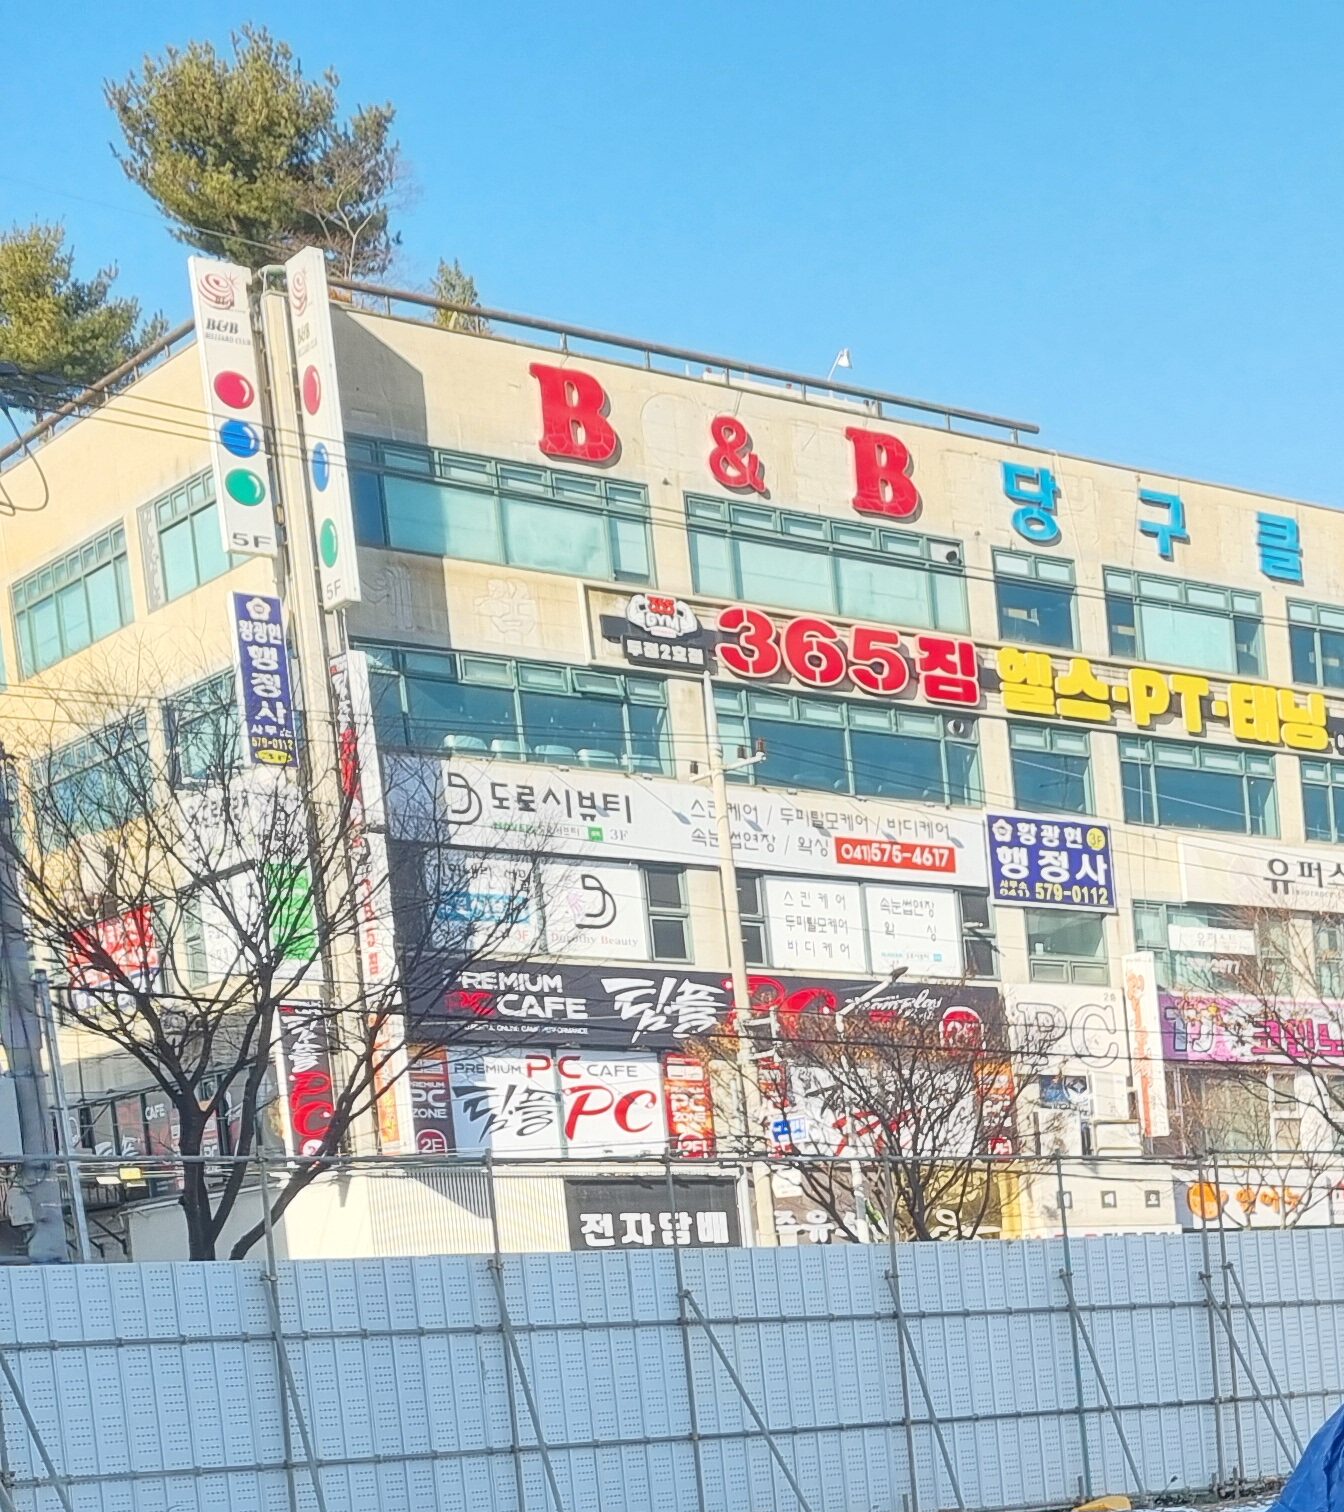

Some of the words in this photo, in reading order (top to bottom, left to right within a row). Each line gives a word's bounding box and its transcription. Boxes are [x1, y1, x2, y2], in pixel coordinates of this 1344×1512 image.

[205, 317, 239, 335] B&B
[529, 362, 617, 462] B
[709, 414, 766, 493] &
[844, 426, 921, 518] B
[231, 532, 272, 548] 5F
[326, 579, 342, 600] 5F
[645, 612, 681, 633] GYM
[716, 607, 981, 705] 365짐
[246, 644, 288, 725] 행정사
[251, 737, 294, 751] 579-0112
[490, 782, 632, 824] 도로시뷰티
[610, 828, 629, 841] 3F
[886, 818, 950, 840] 바디케어
[841, 842, 950, 868] 041)575-4617
[995, 846, 1108, 886] 행정사
[1035, 882, 1109, 905] 579-0112
[601, 935, 639, 947] Beauty
[496, 993, 589, 1020] CAFE
[1016, 1002, 1119, 1068] PC
[453, 1062, 522, 1076] PREMIUM
[586, 1064, 639, 1078] CAFE
[411, 1108, 448, 1118] ZONE
[562, 1084, 658, 1142] PC
[580, 1211, 730, 1247] 전자담배
